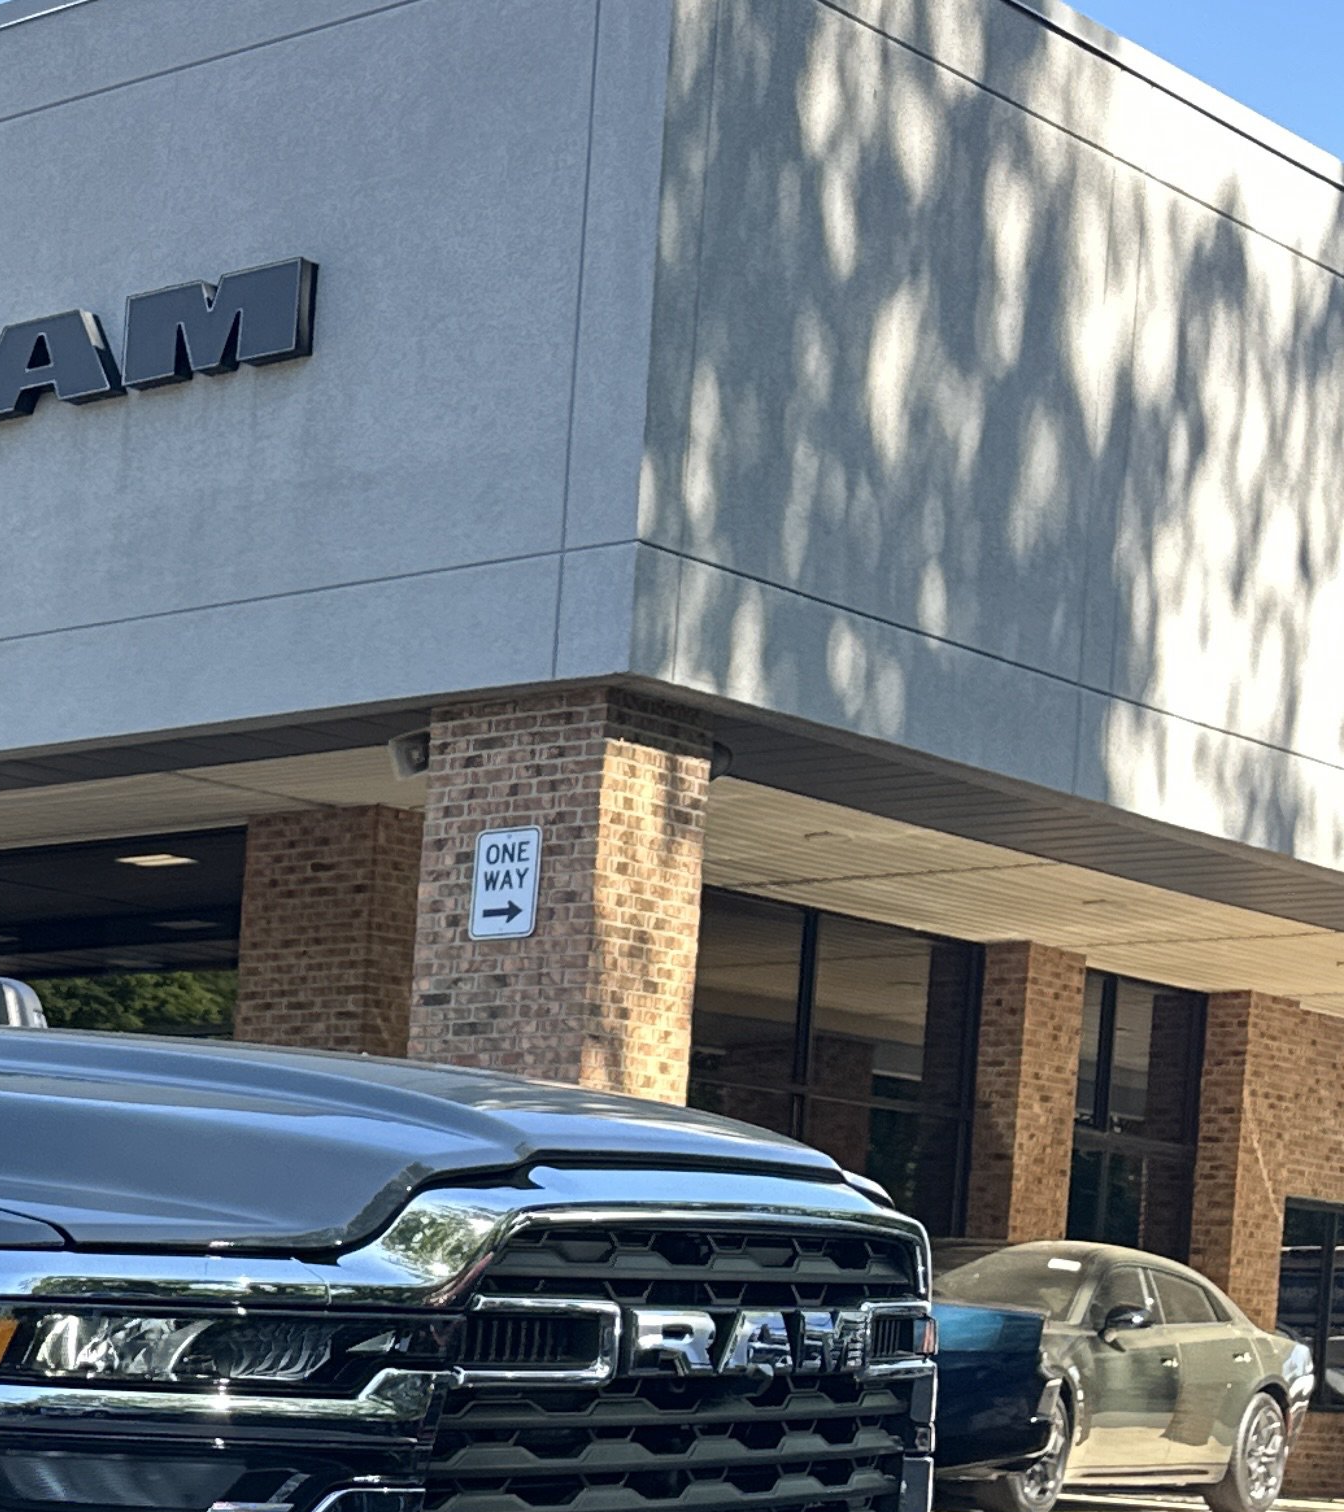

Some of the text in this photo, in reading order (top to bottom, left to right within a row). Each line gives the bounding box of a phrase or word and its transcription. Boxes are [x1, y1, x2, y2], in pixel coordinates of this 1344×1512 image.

[486, 841, 530, 865] ONE
[484, 867, 529, 891] WAY
[630, 1310, 866, 1376] RAM
